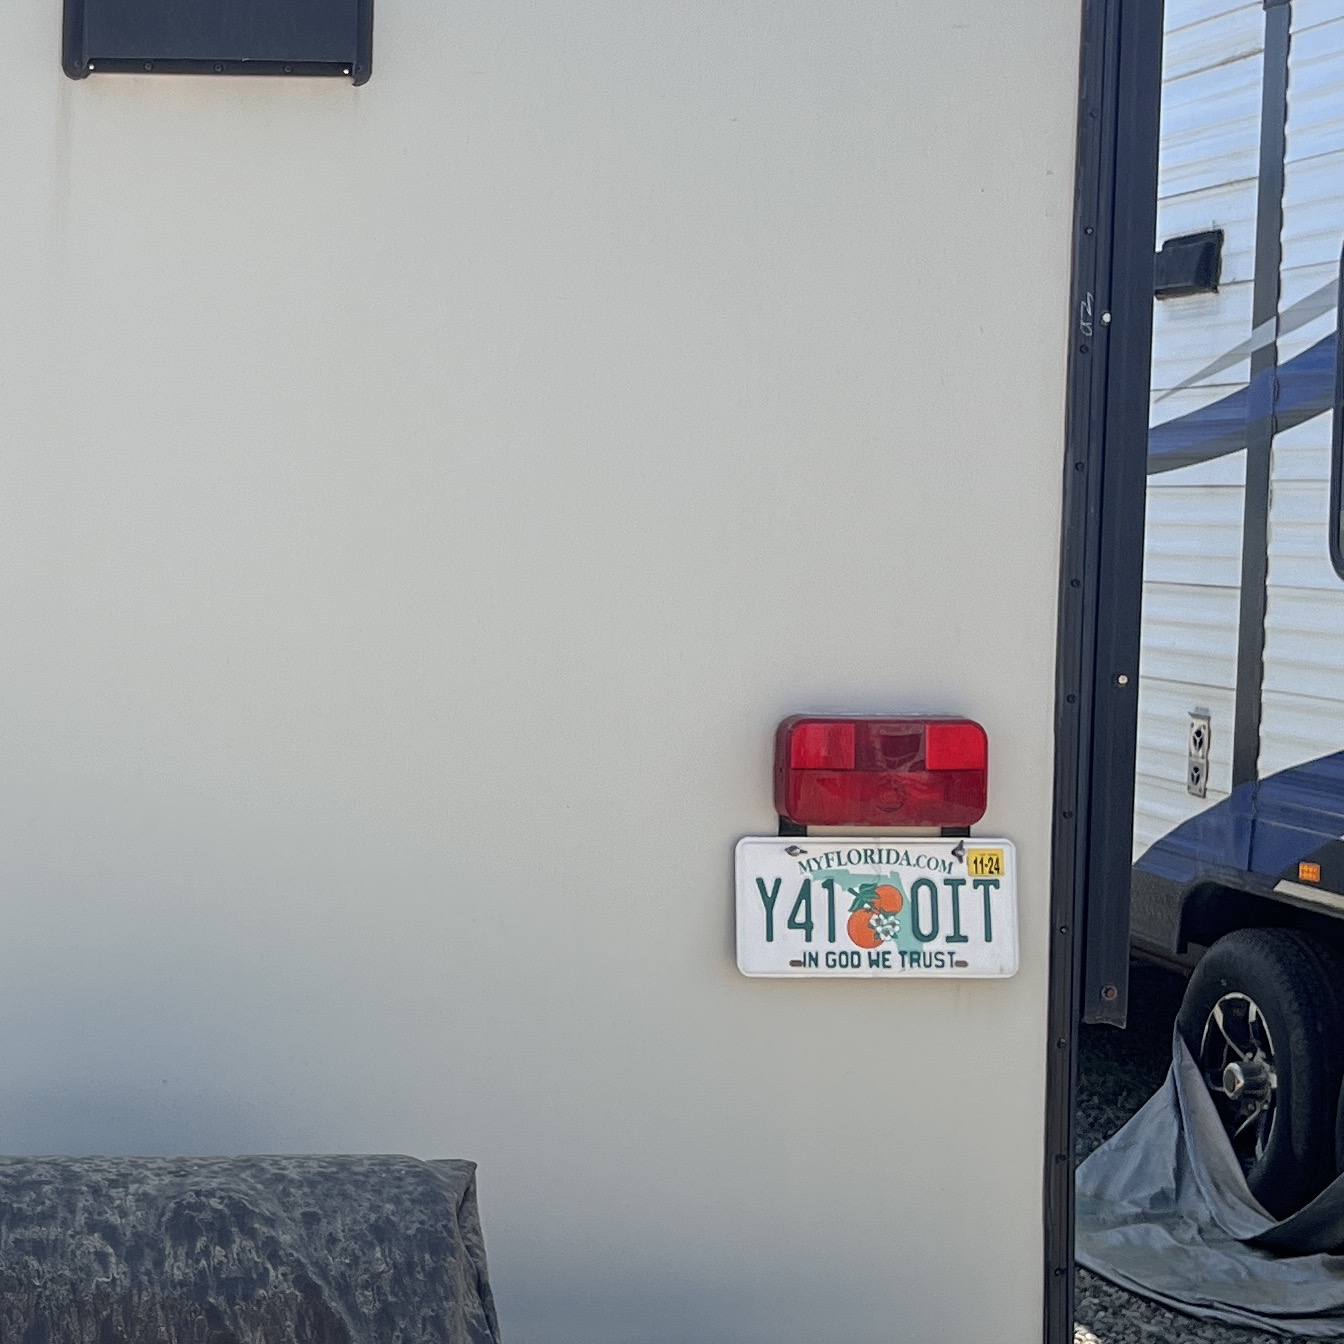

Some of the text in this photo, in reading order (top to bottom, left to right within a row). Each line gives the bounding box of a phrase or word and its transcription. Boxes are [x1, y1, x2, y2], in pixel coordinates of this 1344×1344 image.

[797, 847, 954, 875] MYFLORIDA.COM
[755, 877, 836, 943] Y41
[802, 950, 956, 969] IN GOD WE TRUST
